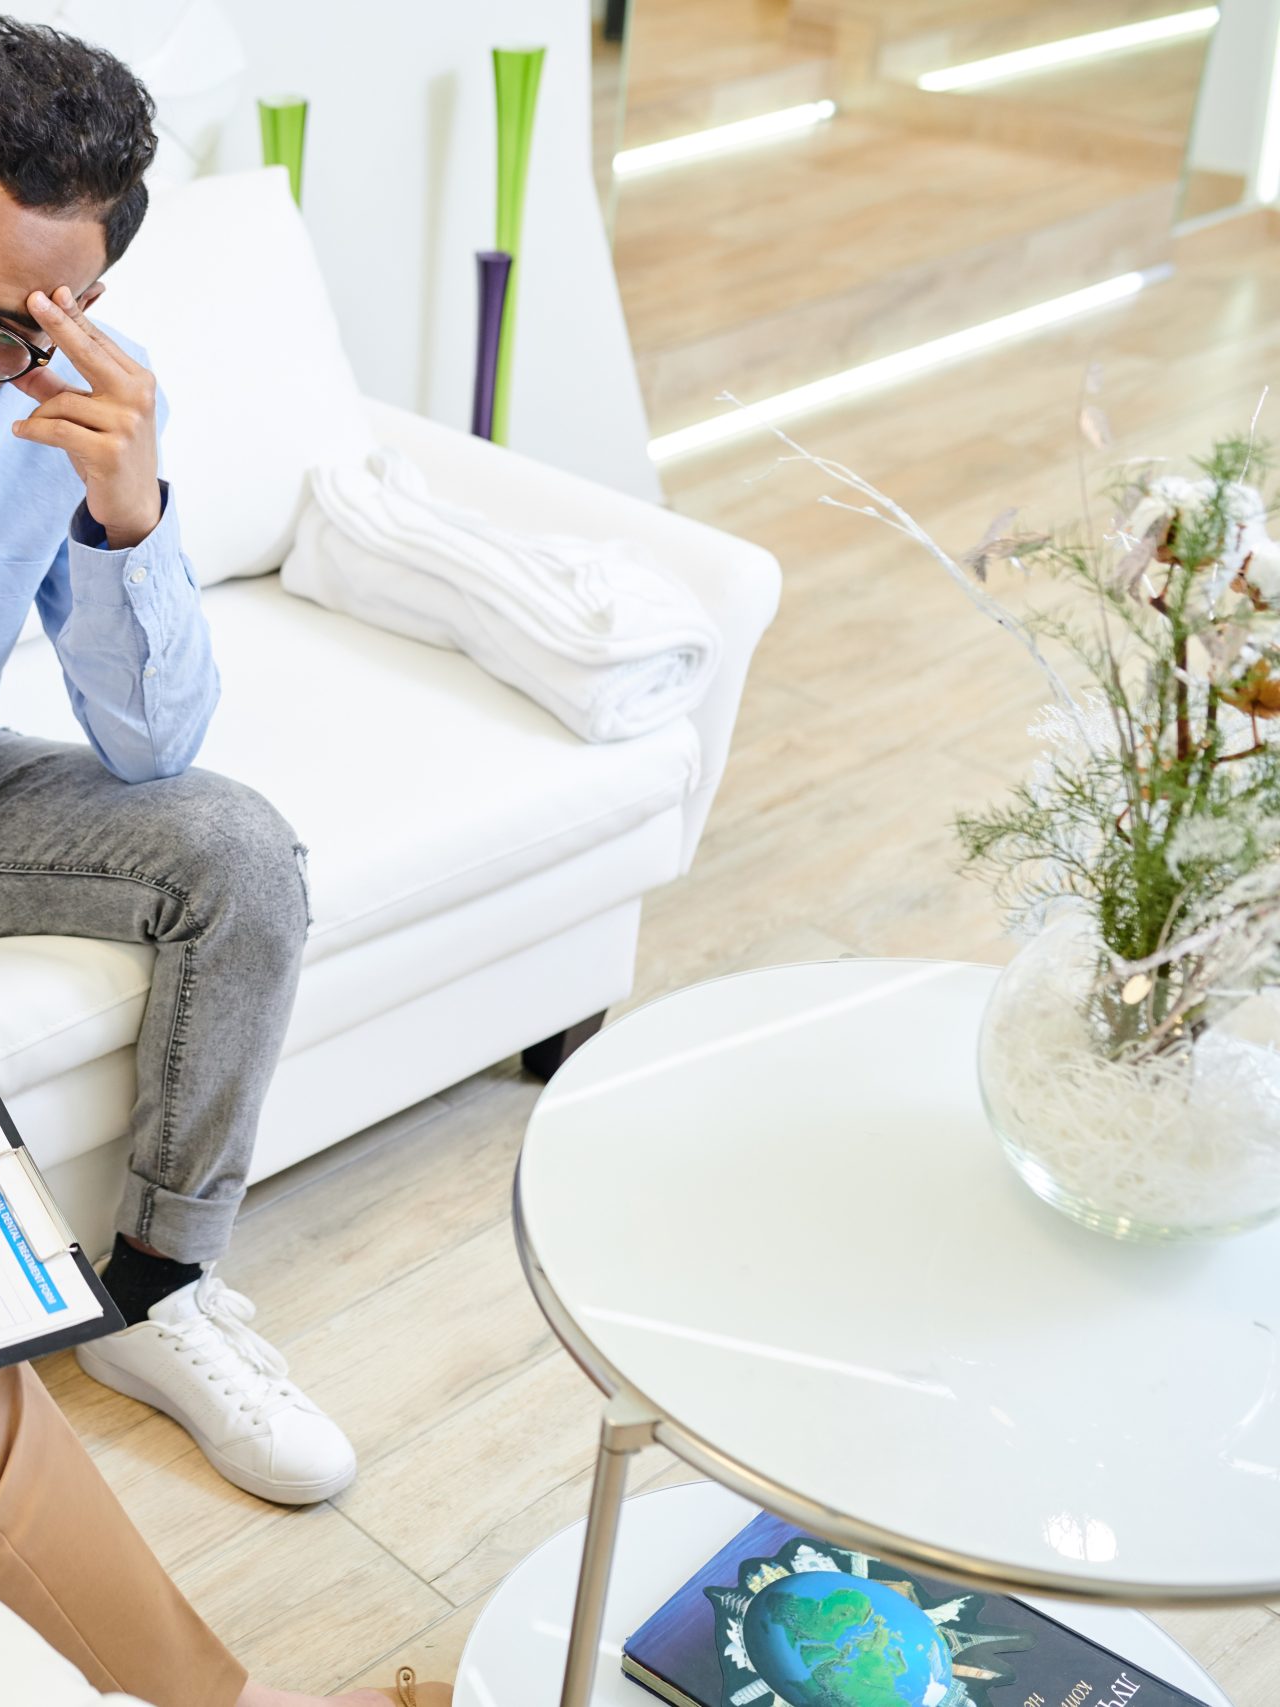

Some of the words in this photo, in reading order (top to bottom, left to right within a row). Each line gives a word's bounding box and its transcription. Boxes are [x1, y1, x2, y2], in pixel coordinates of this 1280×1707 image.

[1, 1212, 21, 1241] DENTAL
[17, 1239, 44, 1284] TREATMENT
[38, 1279, 56, 1305] FORM
